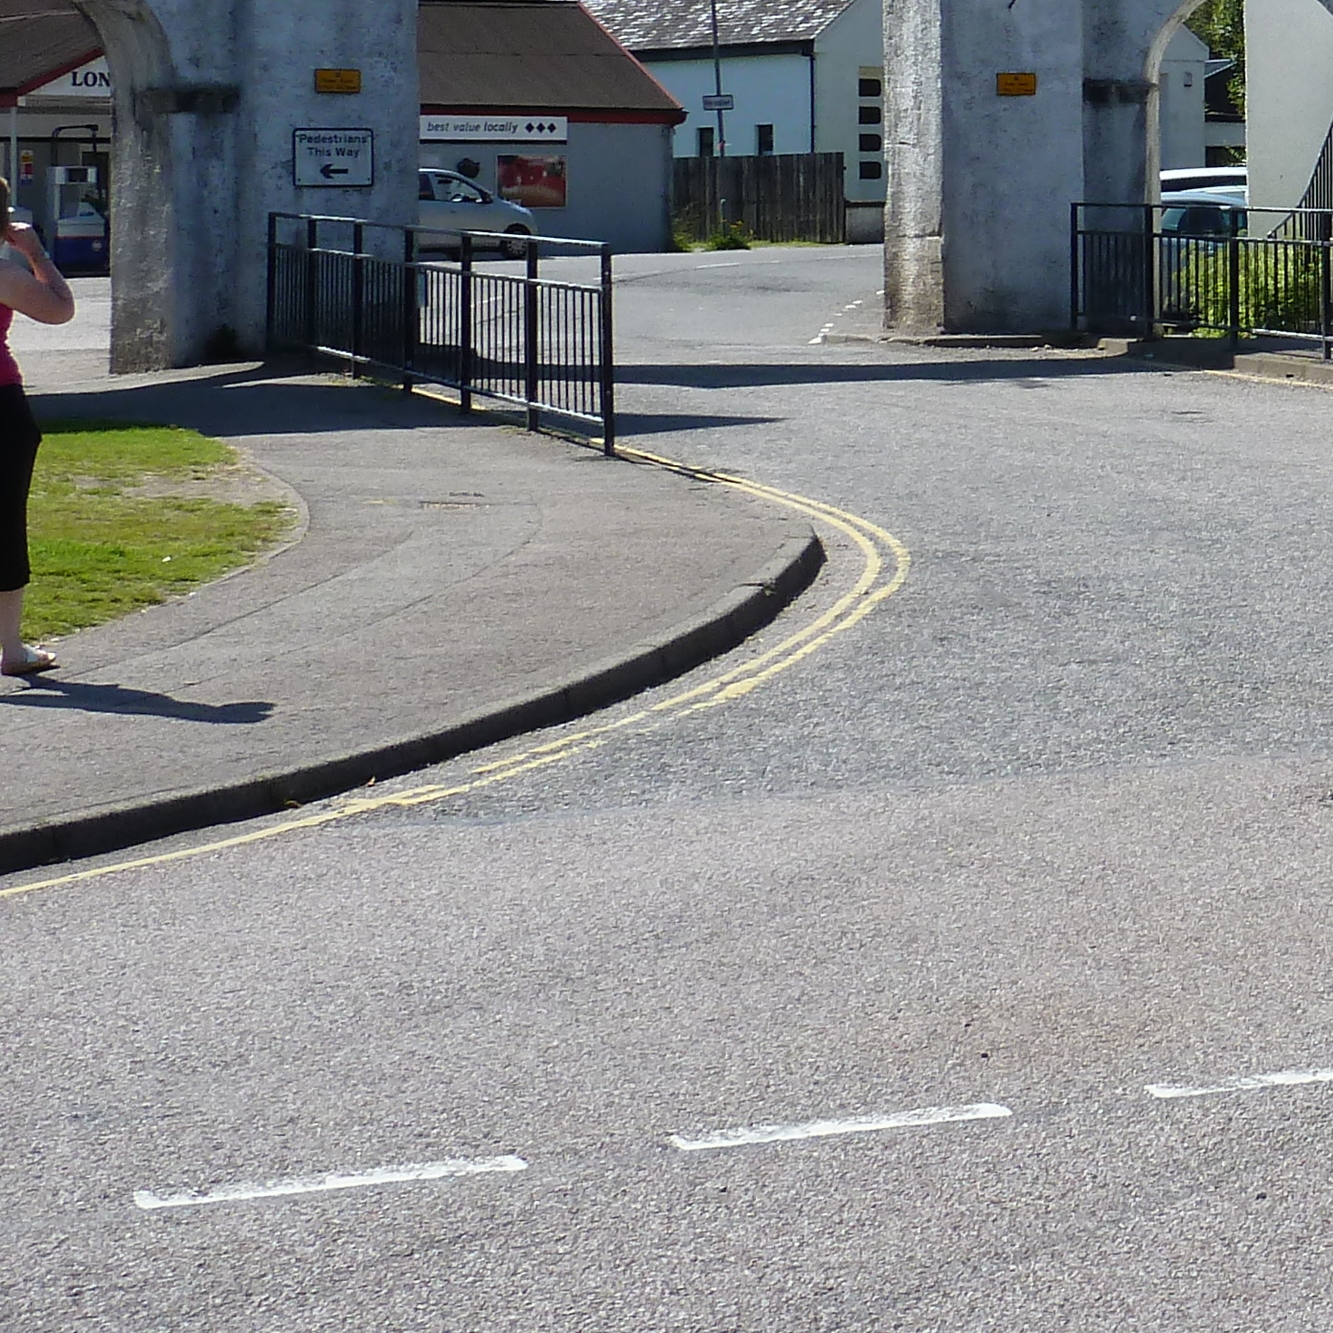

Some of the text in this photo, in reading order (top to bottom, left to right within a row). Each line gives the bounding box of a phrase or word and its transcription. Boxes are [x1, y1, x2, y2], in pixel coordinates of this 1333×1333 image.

[427, 121, 519, 134] best value locally
[299, 133, 368, 144] Pedestrians
[307, 146, 360, 158] This Way
